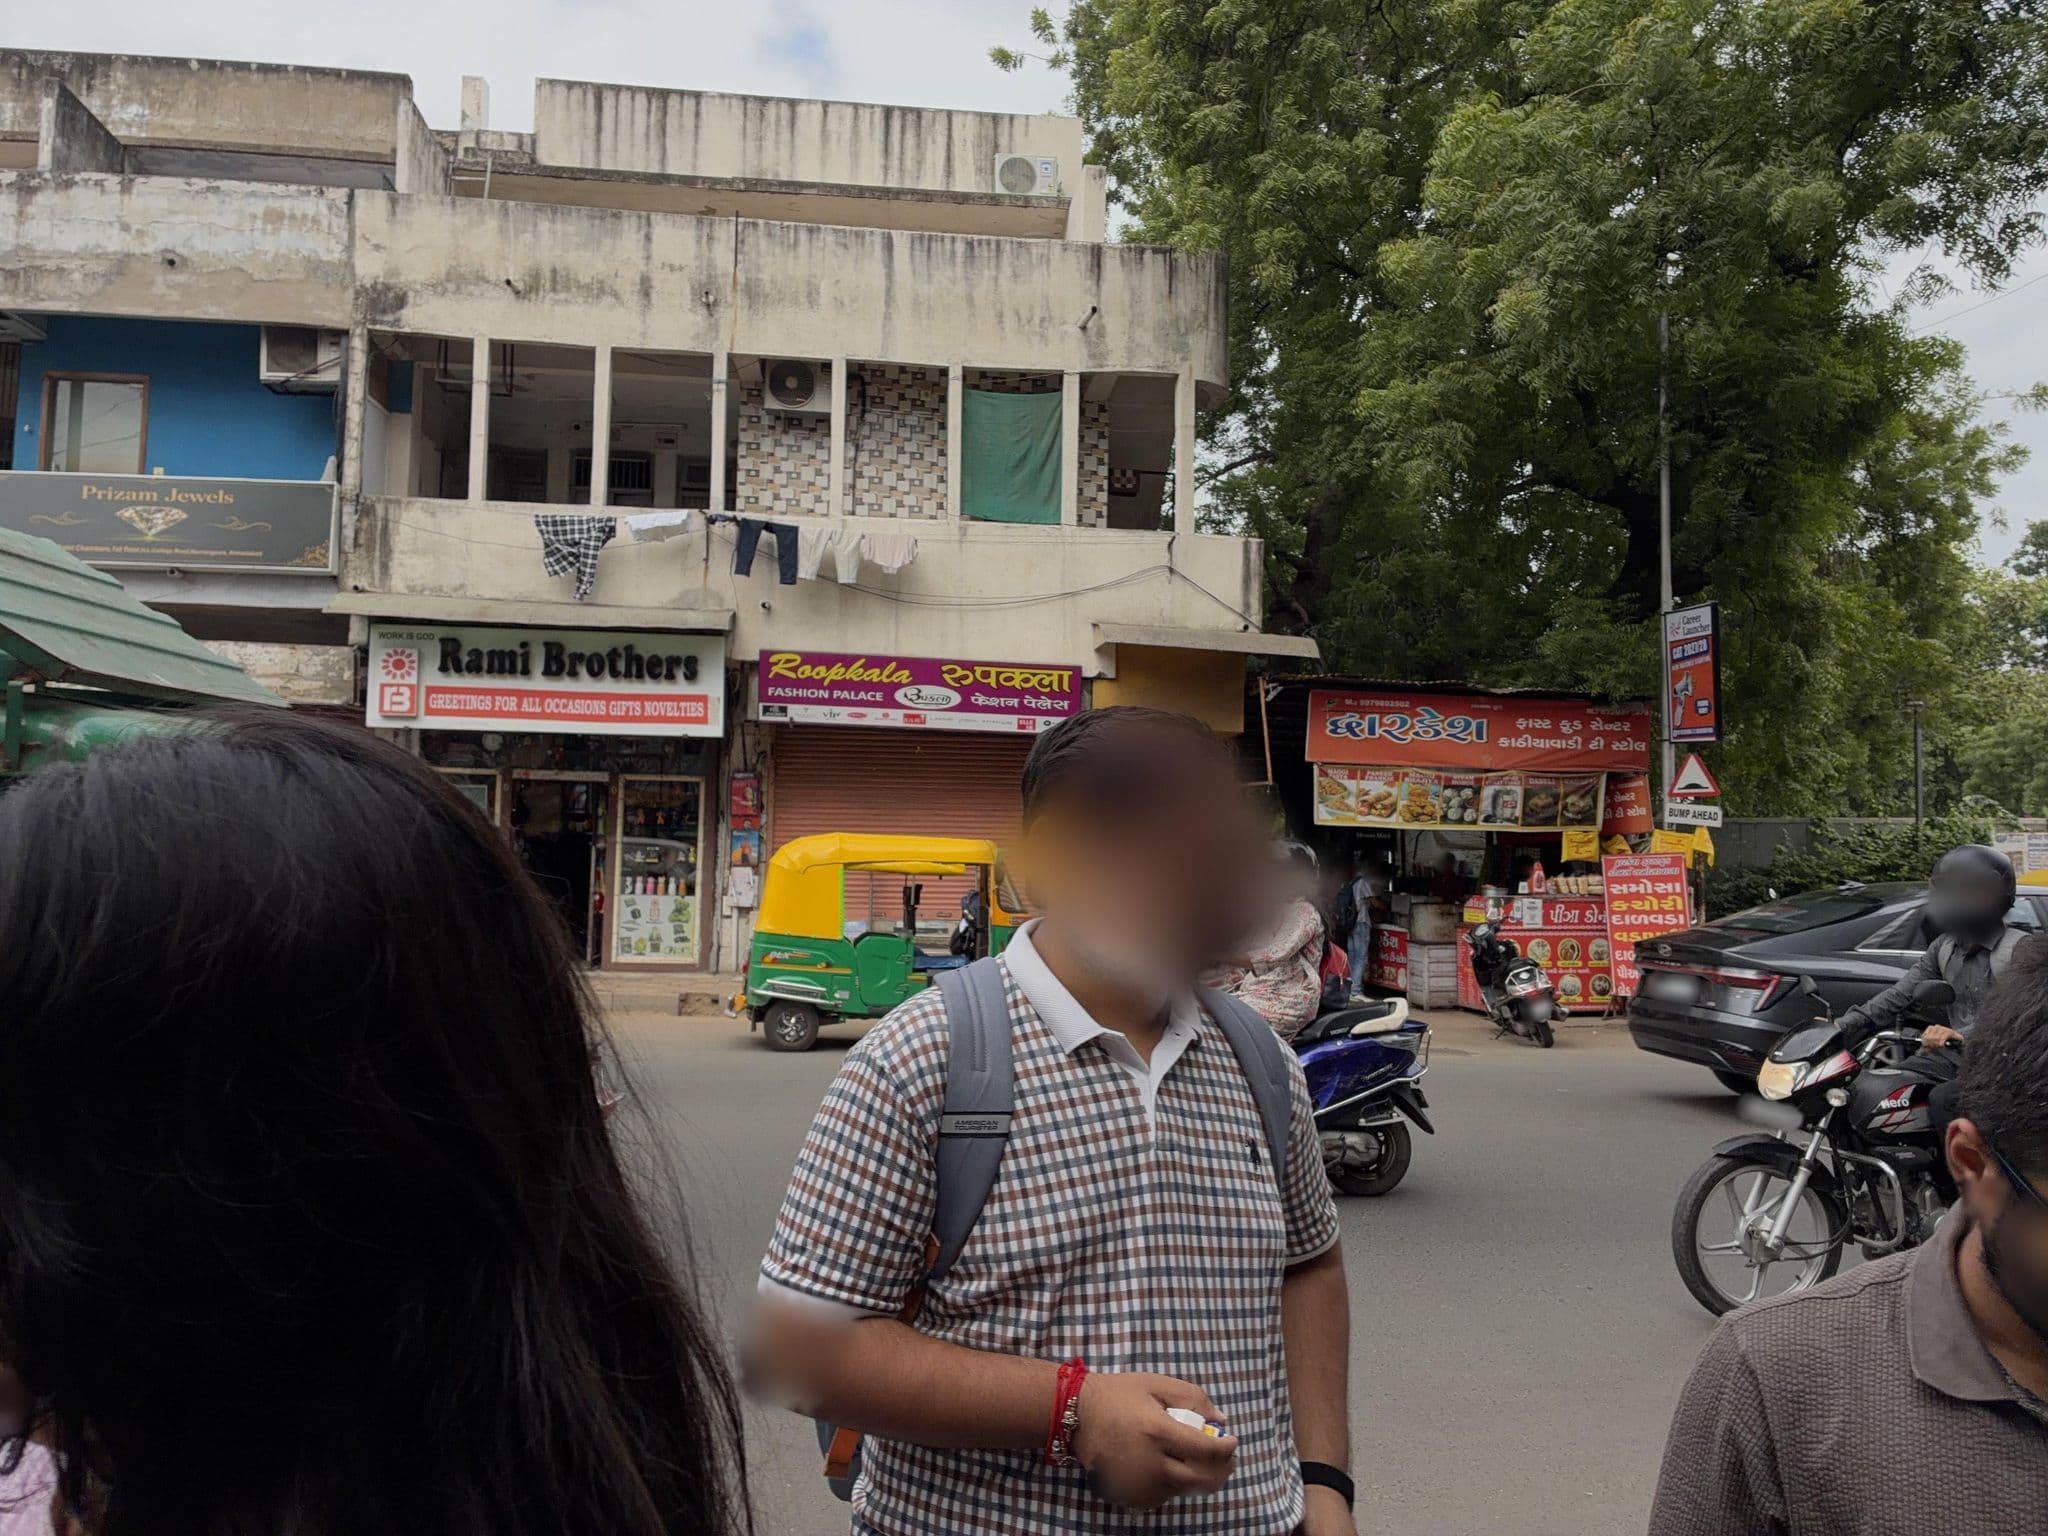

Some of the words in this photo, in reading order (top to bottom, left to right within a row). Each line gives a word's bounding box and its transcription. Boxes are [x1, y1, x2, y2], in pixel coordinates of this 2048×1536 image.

[81, 484, 157, 502] Prizam
[164, 488, 234, 504] Jewels
[1682, 615, 1702, 625] Career
[378, 632, 404, 640] WORK
[406, 632, 414, 640] IS
[416, 632, 436, 640] GOD
[1682, 623, 1710, 636] Launcher
[438, 638, 531, 676] Rami
[541, 641, 699, 682] Brothers
[768, 653, 912, 686] Roopkala
[767, 687, 830, 699] FASHION
[833, 690, 884, 702] PALACE
[429, 693, 492, 711] GREETINGS
[494, 696, 518, 711] FOR
[521, 697, 542, 712] ALL
[544, 698, 606, 715] OCCASIONS
[609, 700, 641, 716] GIFTS
[643, 701, 704, 717] NOVELTIES
[1327, 706, 1488, 744] દ્વારકેશ
[1515, 718, 1552, 730] ફાસ્ટ
[1589, 717, 1632, 732] સેન્ટર
[1588, 736, 1604, 750] ટી
[1611, 737, 1646, 751] સ્ટોલ
[1668, 807, 1691, 819] BUMP
[1691, 809, 1719, 822] AHEAD
[1610, 879, 1681, 895] સમોસા
[1611, 896, 1684, 912] કચોરી
[1880, 1099, 1910, 1109] Hero
